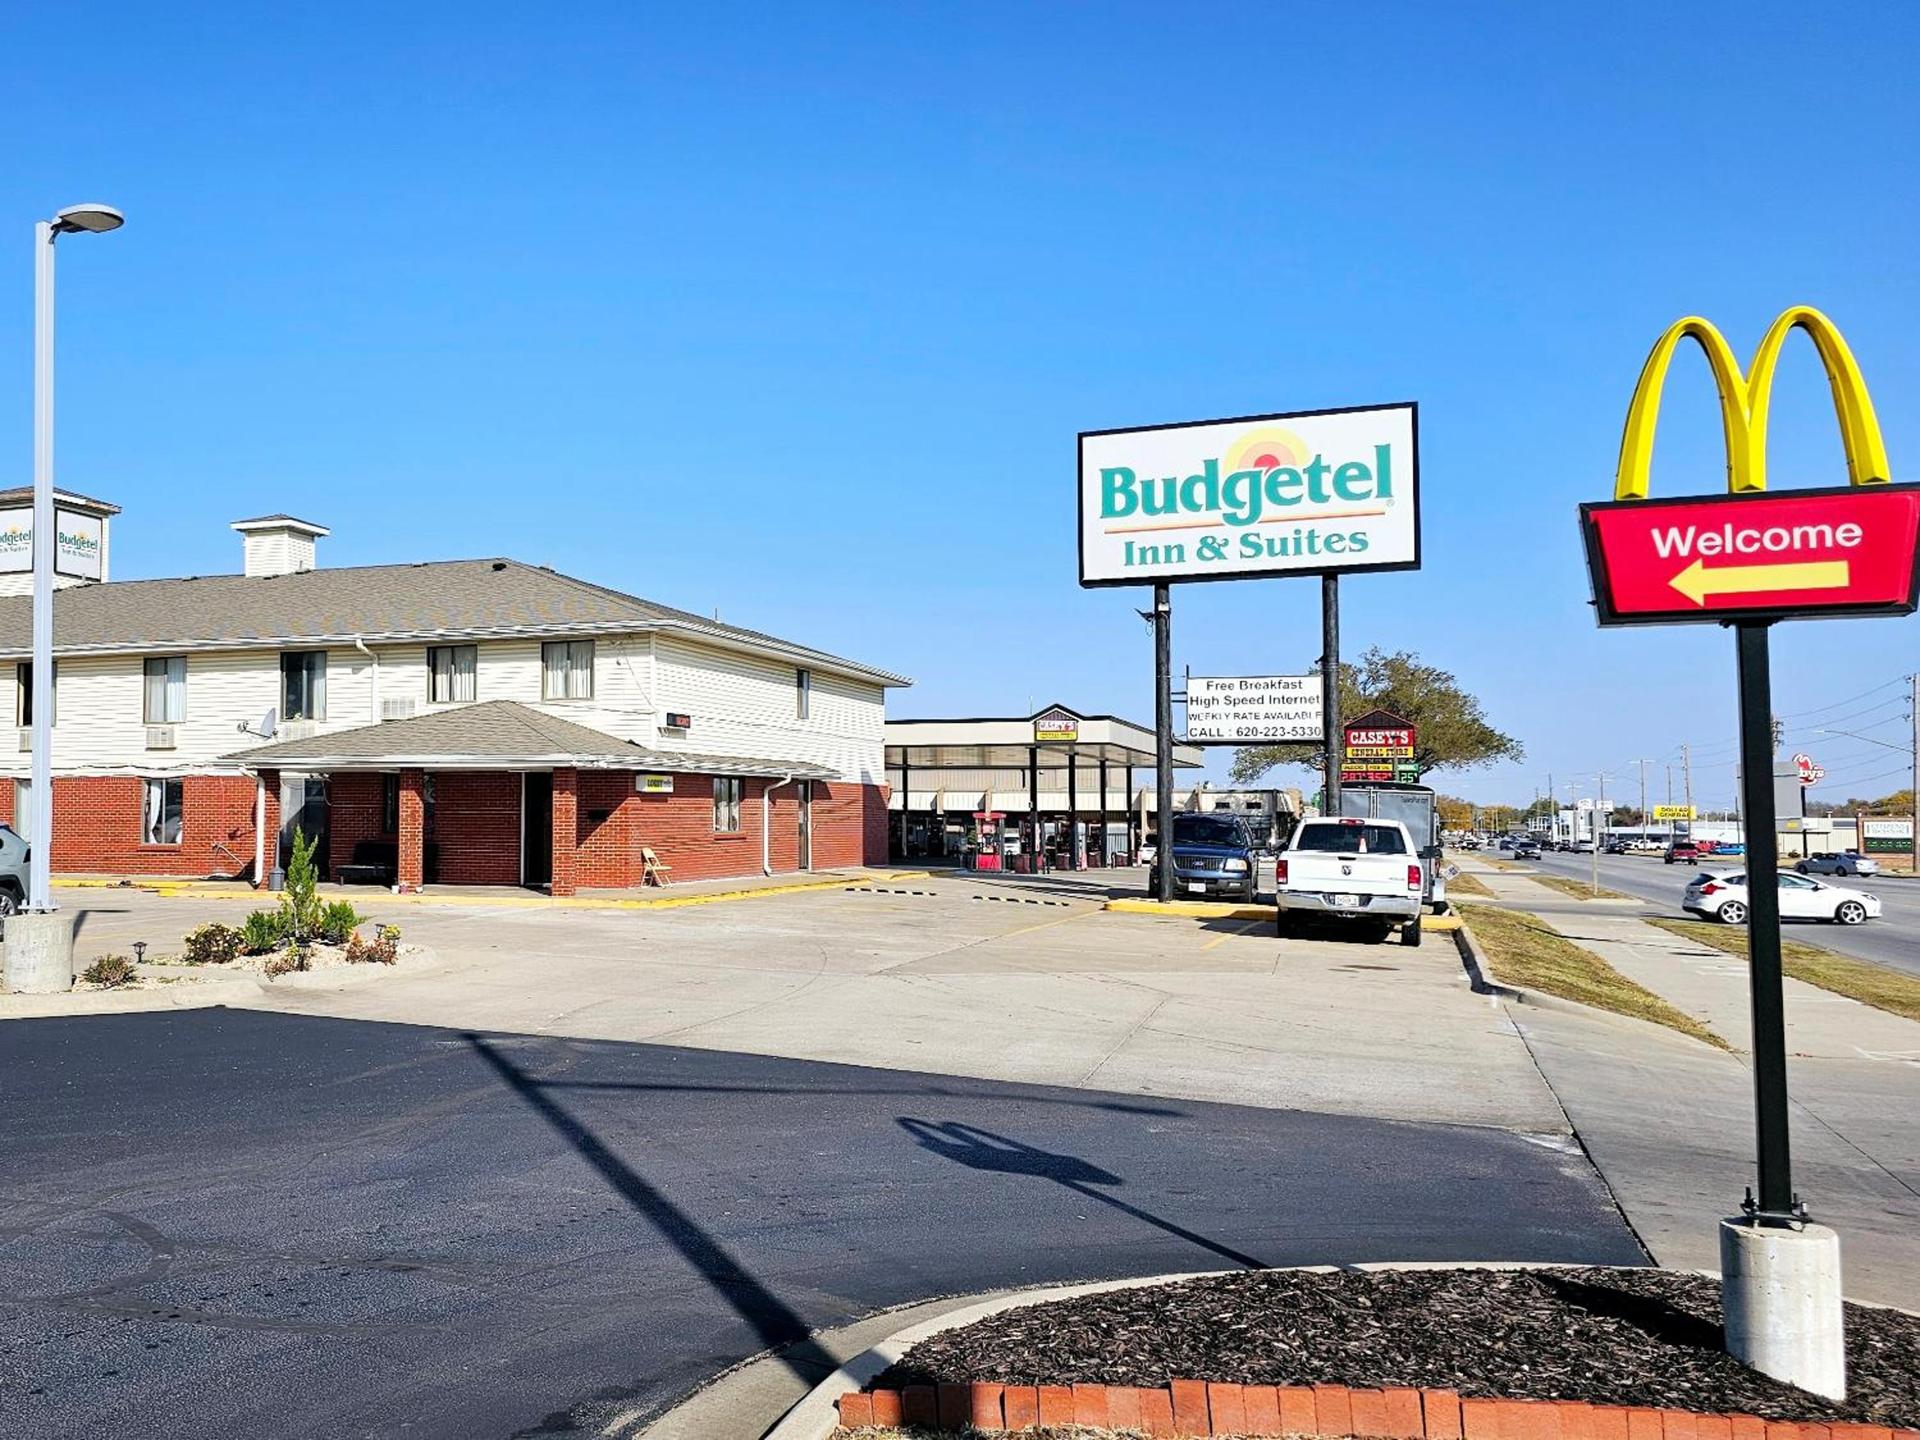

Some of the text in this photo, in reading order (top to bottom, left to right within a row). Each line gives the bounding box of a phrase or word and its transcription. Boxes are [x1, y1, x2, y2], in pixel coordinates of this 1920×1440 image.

[1099, 443, 1394, 526] Budgetel
[59, 532, 98, 549] Budgetel
[1124, 528, 1369, 566] Inn & Suites
[1651, 522, 1863, 558] Welcome
[1206, 679, 1303, 690] Free Breakfast
[1190, 694, 1320, 708] High Speed Internet
[1233, 711, 1261, 720] RATE
[1189, 727, 1224, 737] CALL
[1236, 726, 1321, 737] 620-223-5330
[1350, 730, 1409, 745] CASEY'S
[1351, 748, 1384, 756] GENERAL
[1798, 767, 1825, 780] by's
